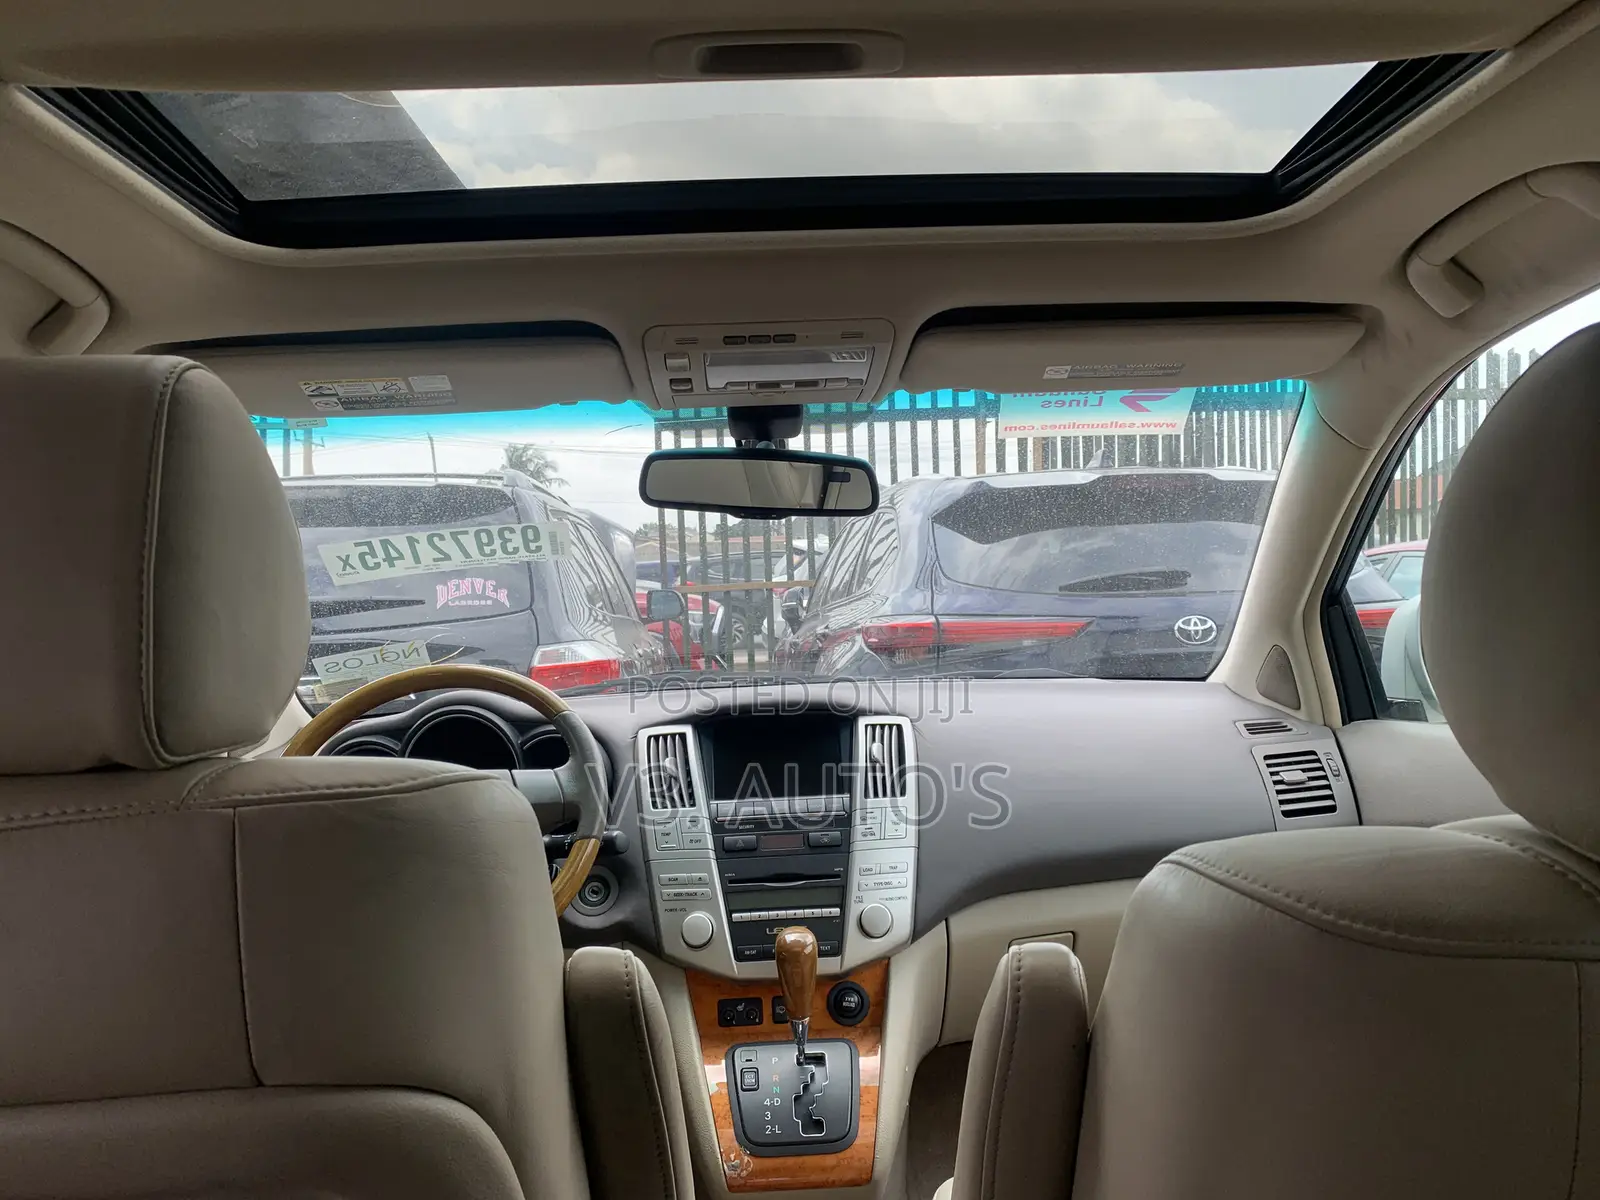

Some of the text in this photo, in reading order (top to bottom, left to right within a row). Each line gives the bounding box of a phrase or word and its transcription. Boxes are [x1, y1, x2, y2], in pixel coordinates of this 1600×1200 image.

[436, 577, 510, 610] DENVER
[772, 1057, 779, 1065] P
[772, 1074, 779, 1082] R
[773, 1086, 780, 1094] N
[764, 1111, 771, 1120] 3
[765, 1124, 782, 1134] 2-L
